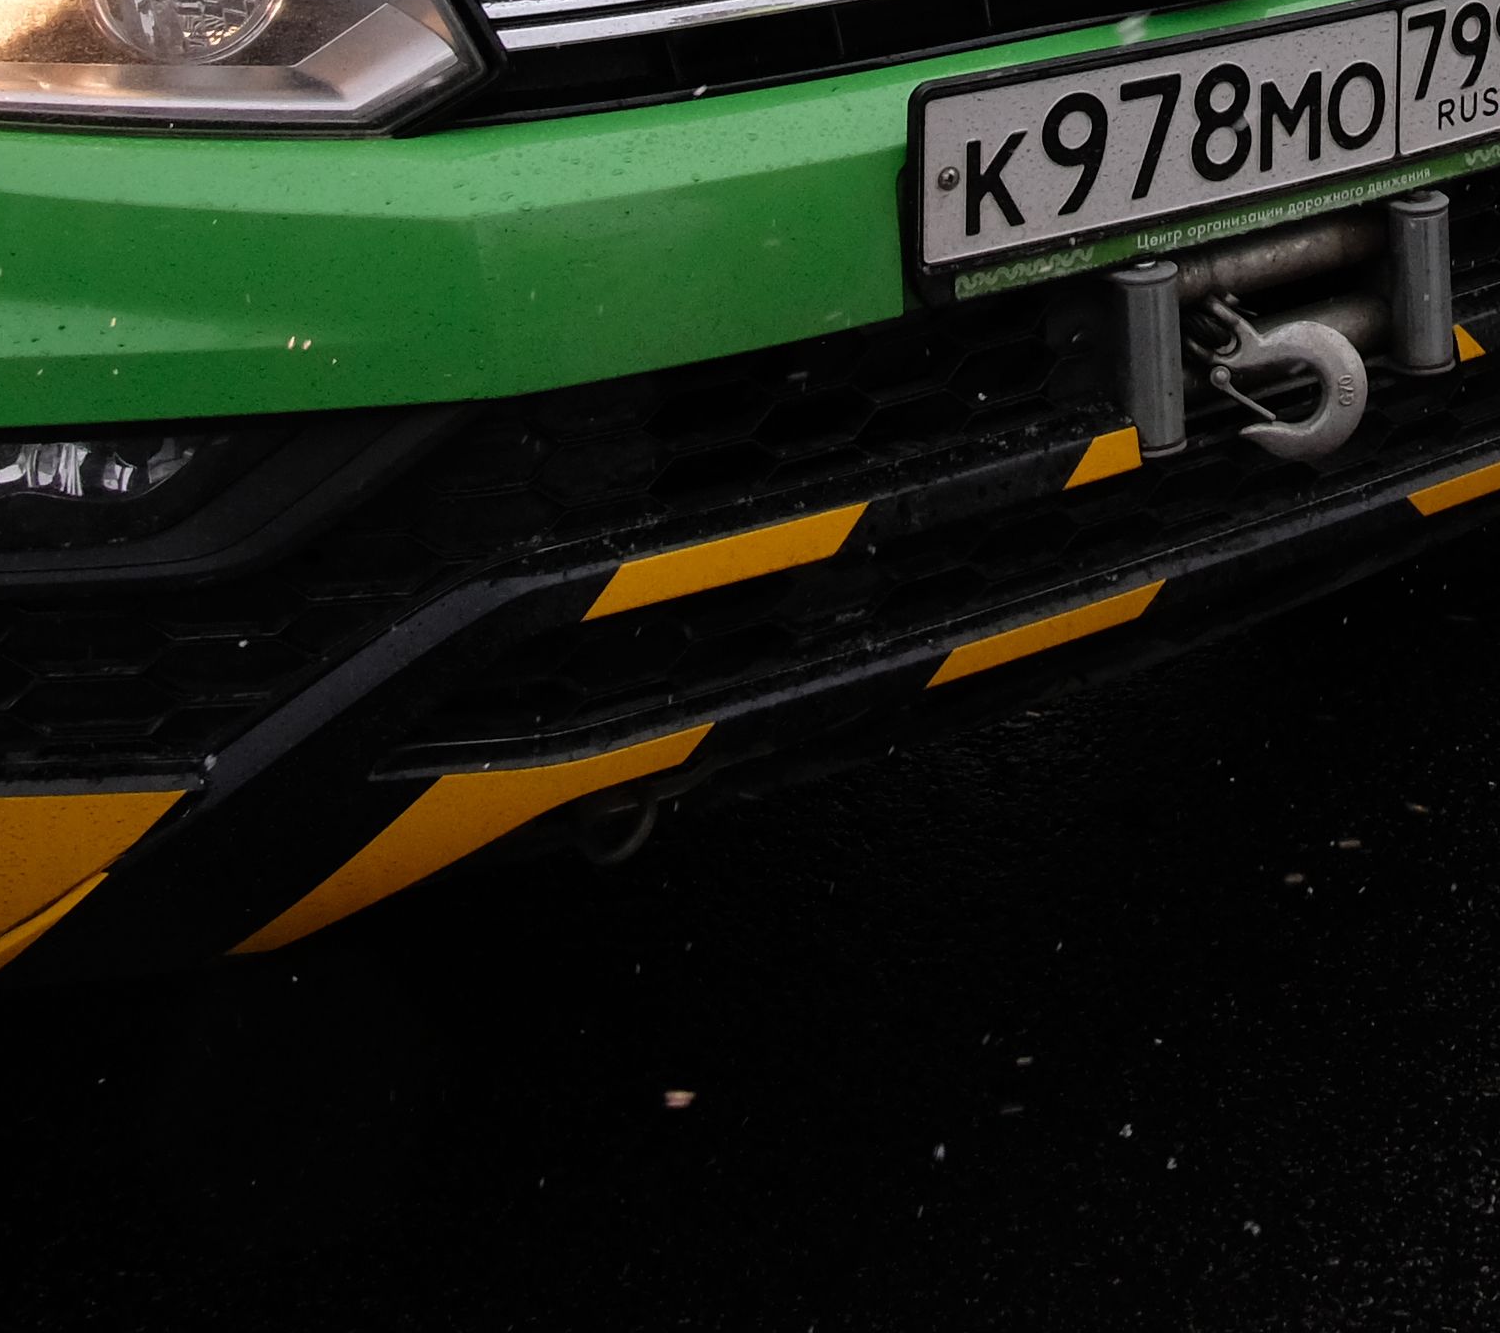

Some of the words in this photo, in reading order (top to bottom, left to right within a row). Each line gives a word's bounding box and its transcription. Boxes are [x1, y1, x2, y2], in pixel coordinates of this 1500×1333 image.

[964, 60, 1386, 237] К978МО
[1437, 87, 1500, 130] RUS
[1137, 229, 1183, 251] Центр
[1187, 206, 1284, 239] организации
[1287, 185, 1364, 215] дорожного
[1367, 167, 1431, 195] движения
